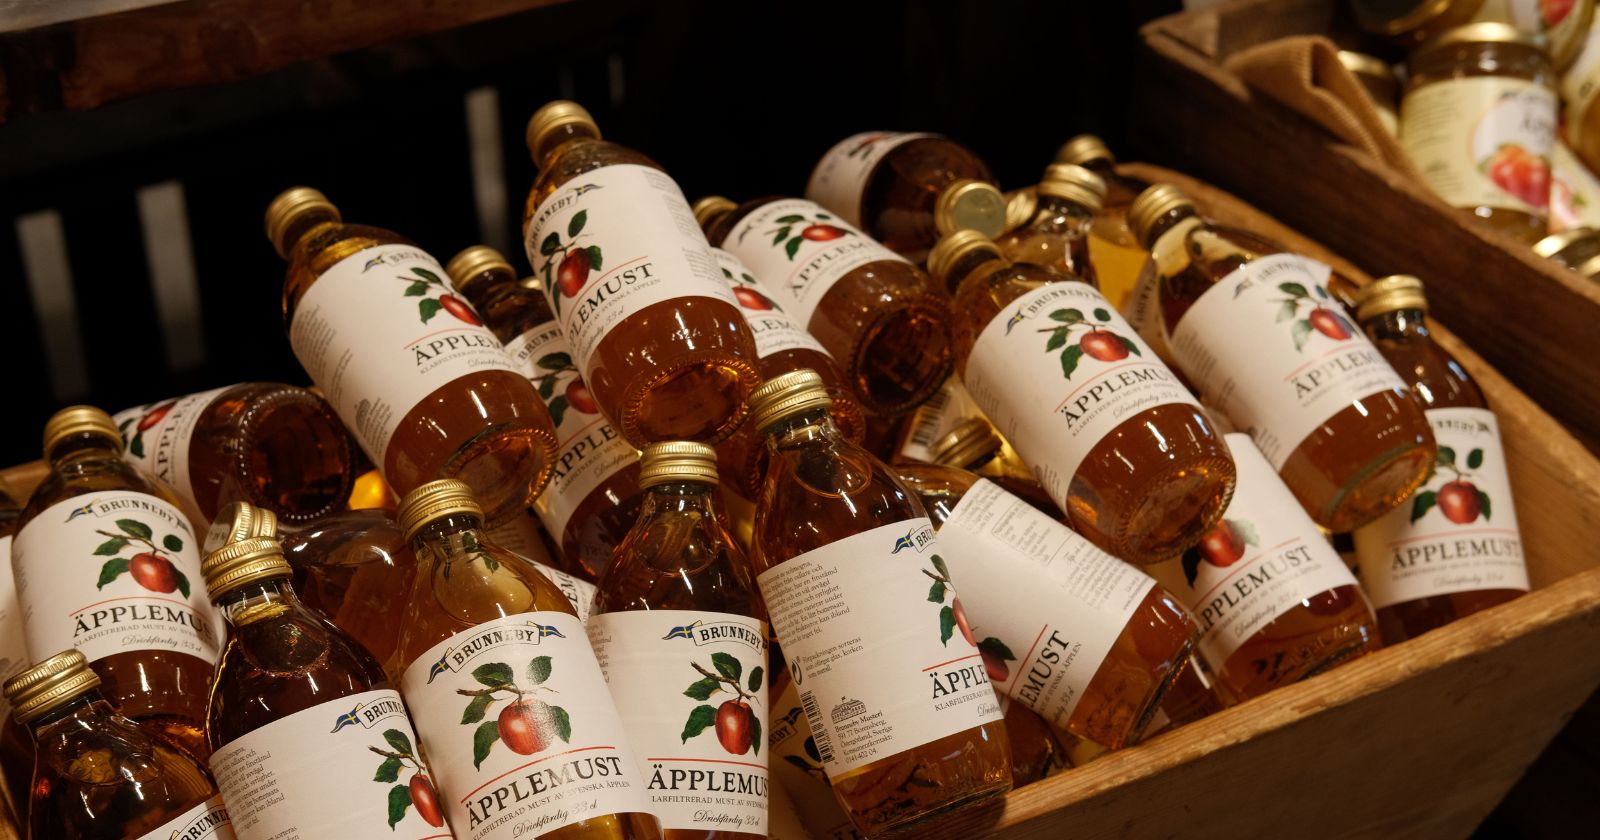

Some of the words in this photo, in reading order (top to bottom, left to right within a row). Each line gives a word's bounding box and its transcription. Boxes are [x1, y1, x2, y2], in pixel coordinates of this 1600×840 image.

[453, 630, 535, 665] BRUNNEBY
[699, 626, 761, 648] BRUNNEBY
[466, 757, 623, 831] ÄPPLEMUST
[528, 797, 550, 810] MUST
[715, 797, 735, 805] MUST
[512, 807, 569, 839] Drickfärdig
[693, 809, 743, 829] Drickfärdig
